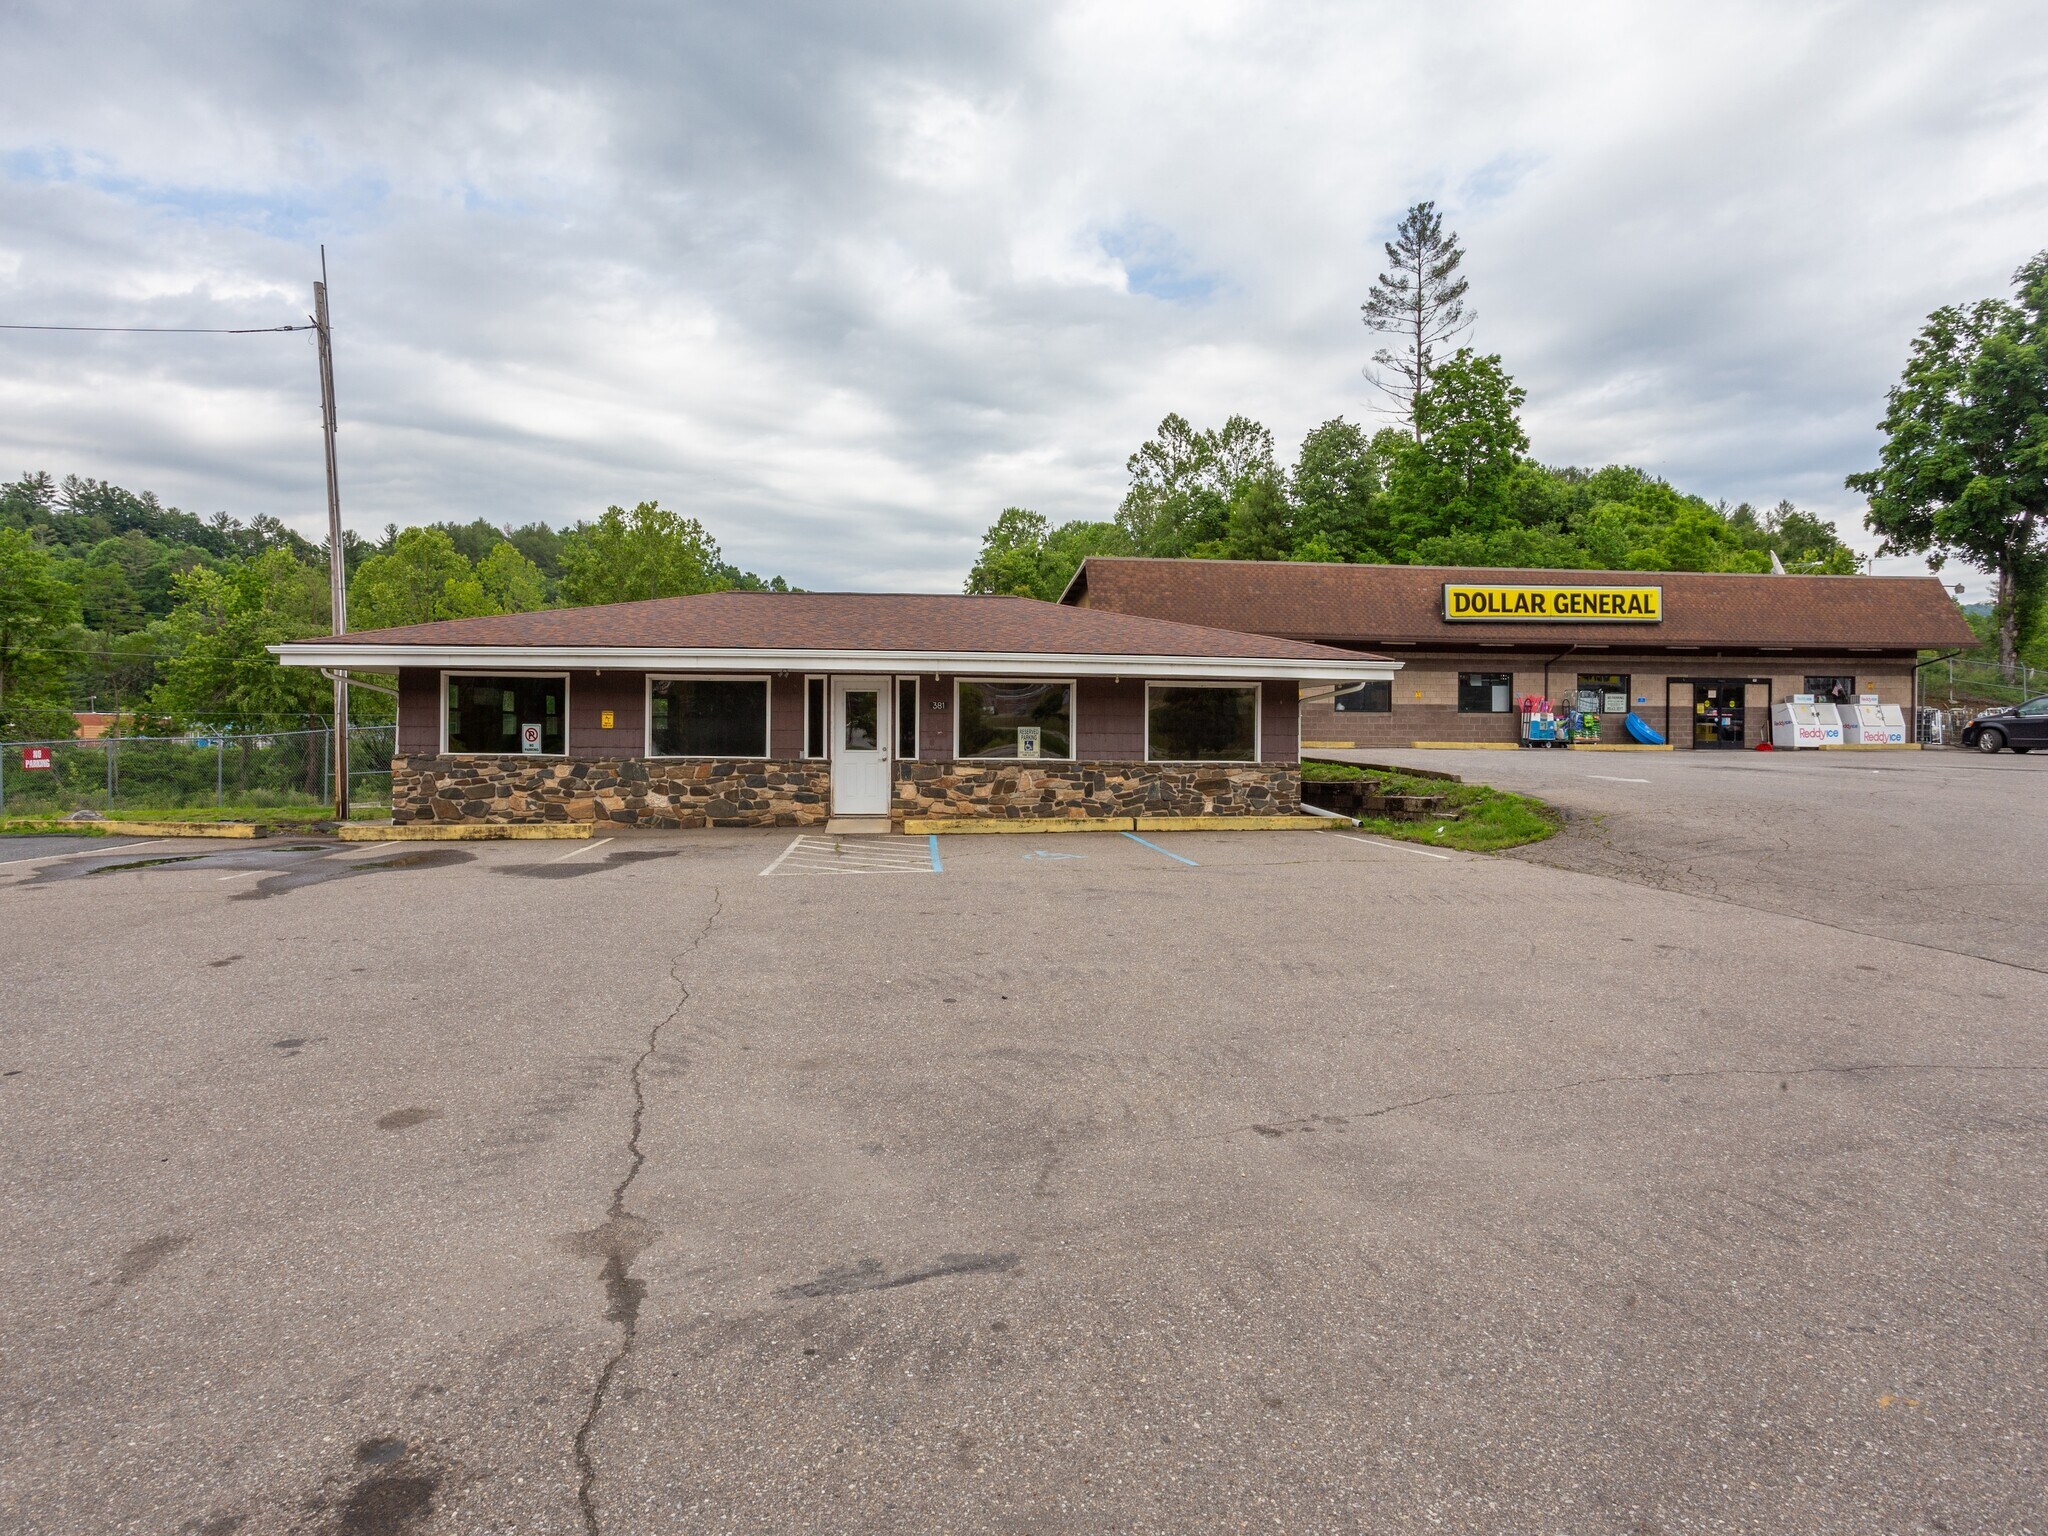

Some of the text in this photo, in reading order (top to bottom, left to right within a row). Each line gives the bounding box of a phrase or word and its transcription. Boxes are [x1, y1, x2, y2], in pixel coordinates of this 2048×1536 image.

[1453, 591, 1656, 614] DOLLAR GENERAL
[932, 702, 944, 710] 381
[32, 750, 42, 758] NO
[25, 759, 50, 768] PARKING
